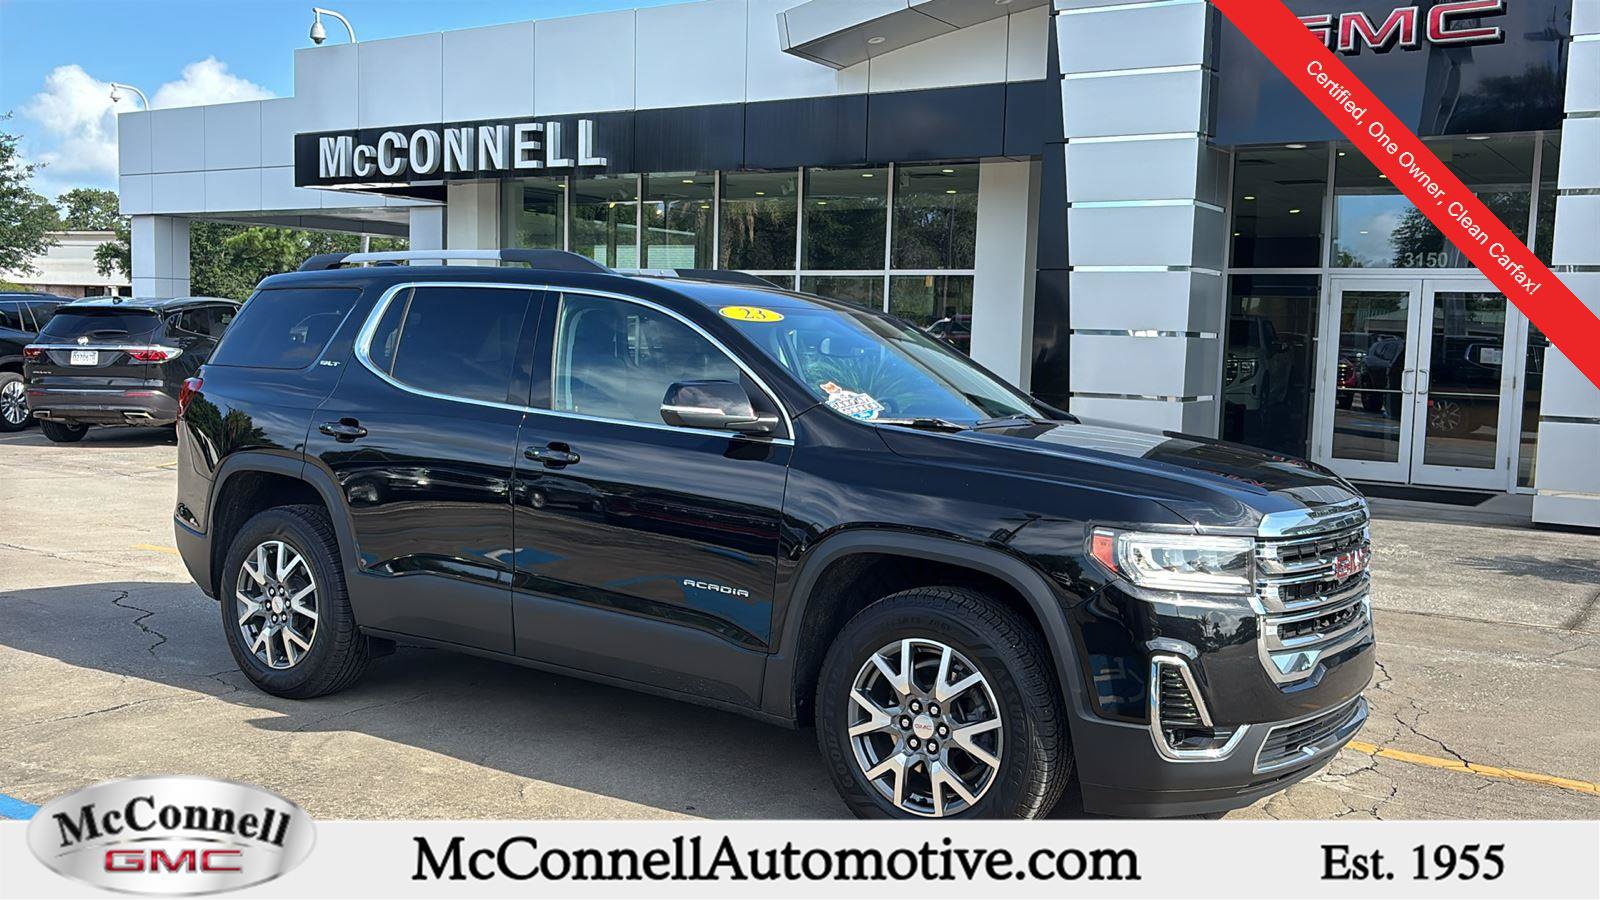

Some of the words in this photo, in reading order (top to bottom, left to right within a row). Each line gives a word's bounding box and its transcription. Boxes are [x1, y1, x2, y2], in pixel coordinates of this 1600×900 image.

[1403, 251, 1448, 268] 3150
[738, 307, 767, 320] 23
[683, 579, 749, 598] ACADIA
